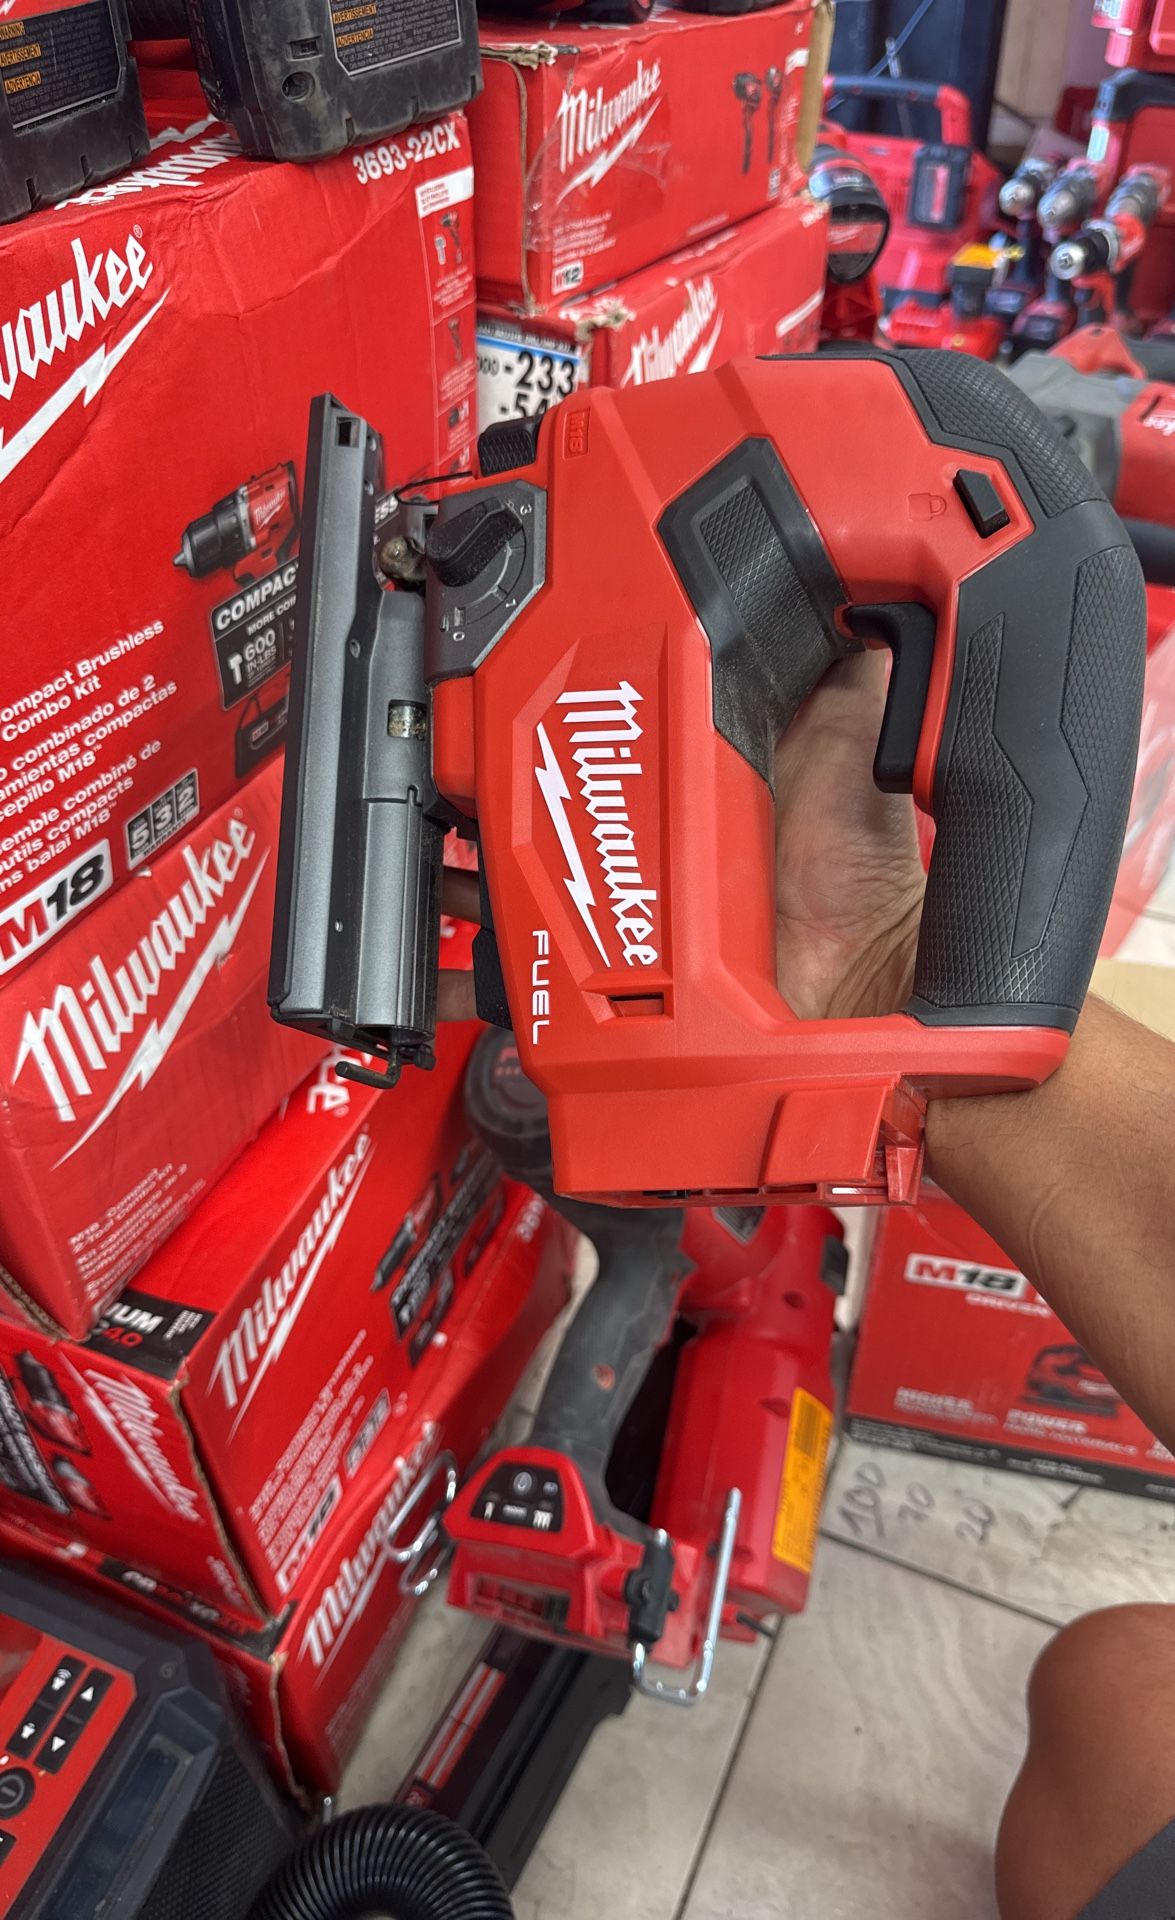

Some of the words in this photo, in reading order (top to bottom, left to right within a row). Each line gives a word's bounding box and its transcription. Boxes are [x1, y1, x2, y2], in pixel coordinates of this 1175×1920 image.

[353, 121, 461, 185] 3693-22CX
[0, 670, 74, 722] ompact
[76, 620, 164, 678] Brushless
[244, 628, 276, 661] 600
[0, 743, 80, 800] amientas
[83, 681, 177, 747] compactas
[2, 695, 71, 742] Combo
[74, 675, 102, 700] Kit
[12, 703, 114, 771] combinado
[118, 686, 140, 707] de
[143, 674, 156, 692] 2
[47, 776, 134, 841] compacts
[63, 755, 137, 811] combiné
[139, 740, 161, 760] de
[179, 786, 194, 814] 2
[132, 822, 150, 849] 5
[155, 804, 172, 830] 3
[554, 680, 658, 968] Milwaukee
[27, 834, 71, 873] balai
[0, 853, 105, 962] M18
[11, 818, 256, 1121] Milwaukee
[532, 929, 550, 1044] FUEL
[206, 1132, 371, 1408] Milwaukee
[915, 1259, 1017, 1291] M18
